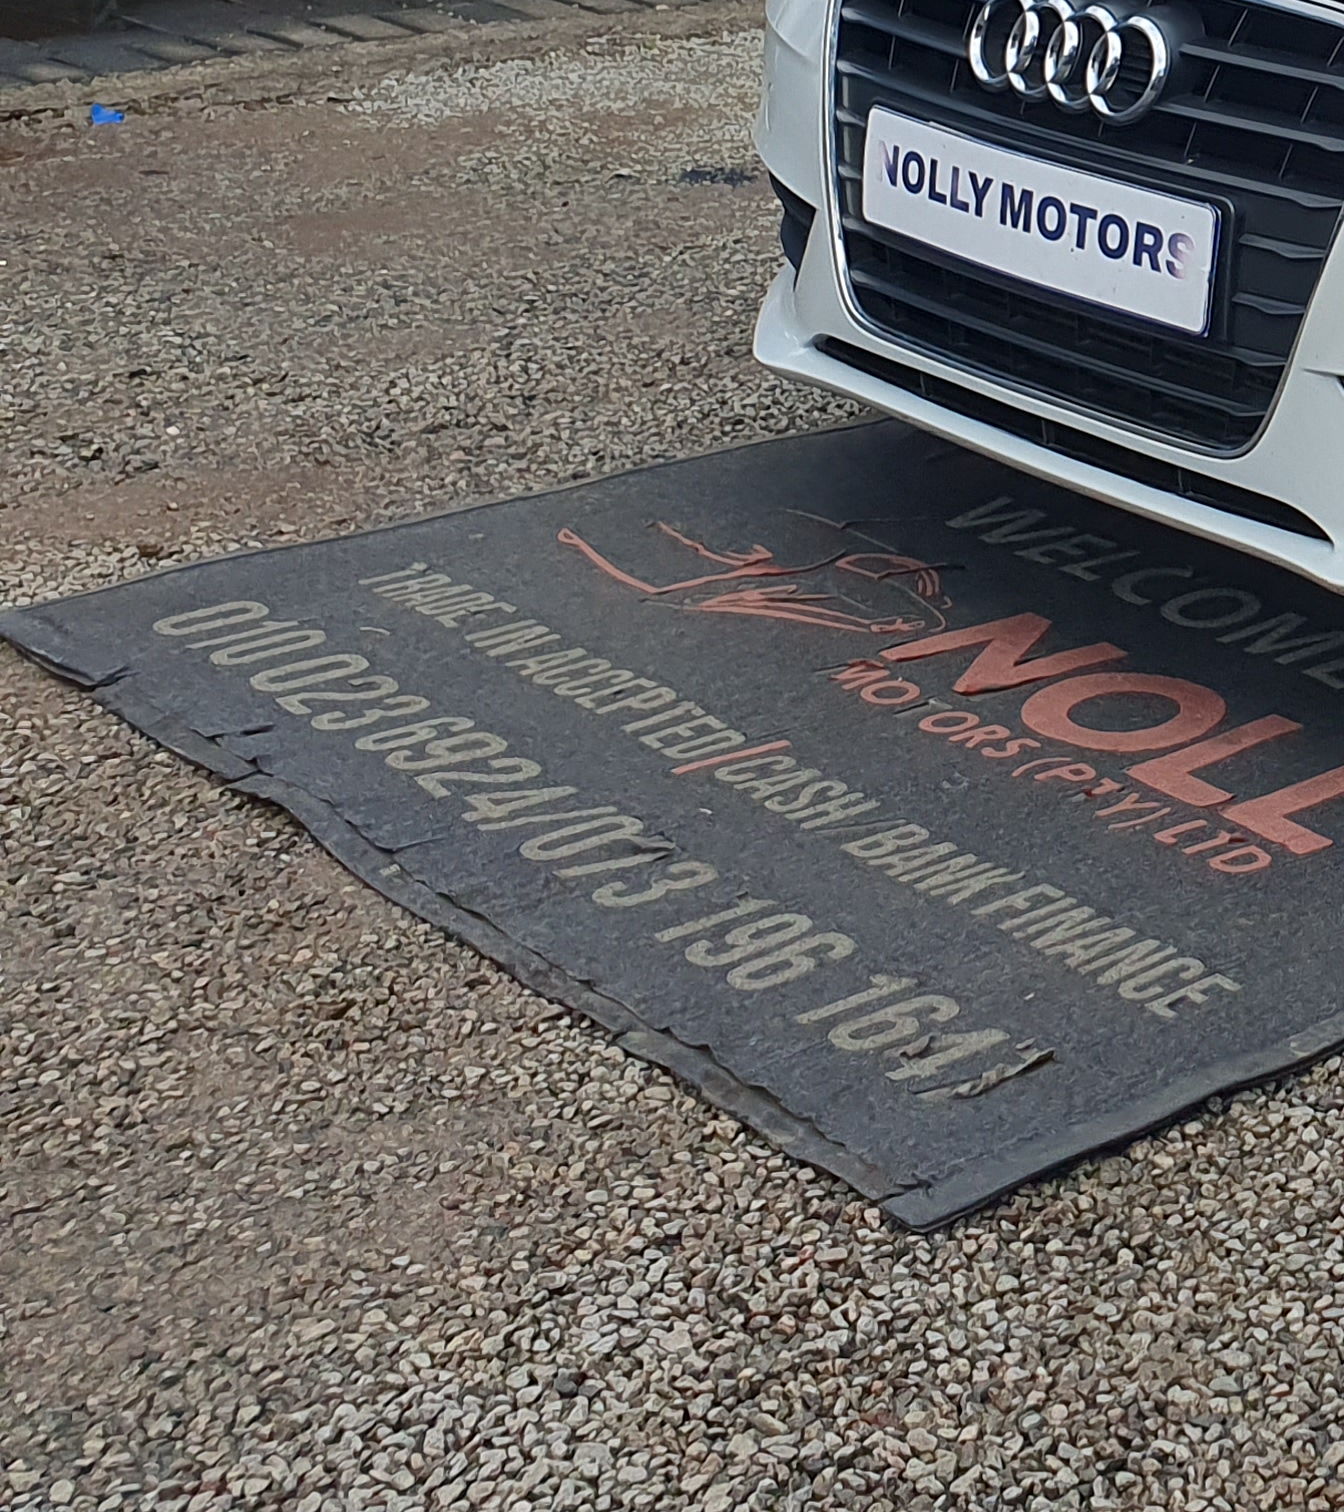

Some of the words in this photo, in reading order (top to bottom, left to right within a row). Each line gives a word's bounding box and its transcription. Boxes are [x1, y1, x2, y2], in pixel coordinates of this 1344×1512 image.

[879, 140, 993, 218] NOLLY
[1000, 182, 1195, 280] MOTORS
[358, 562, 517, 628] TRADE
[465, 619, 561, 657] IN
[970, 883, 1243, 1020] FINANCE
[826, 658, 1042, 758] MOTORS
[1154, 819, 1273, 874] LTD
[654, 892, 858, 990] 196
